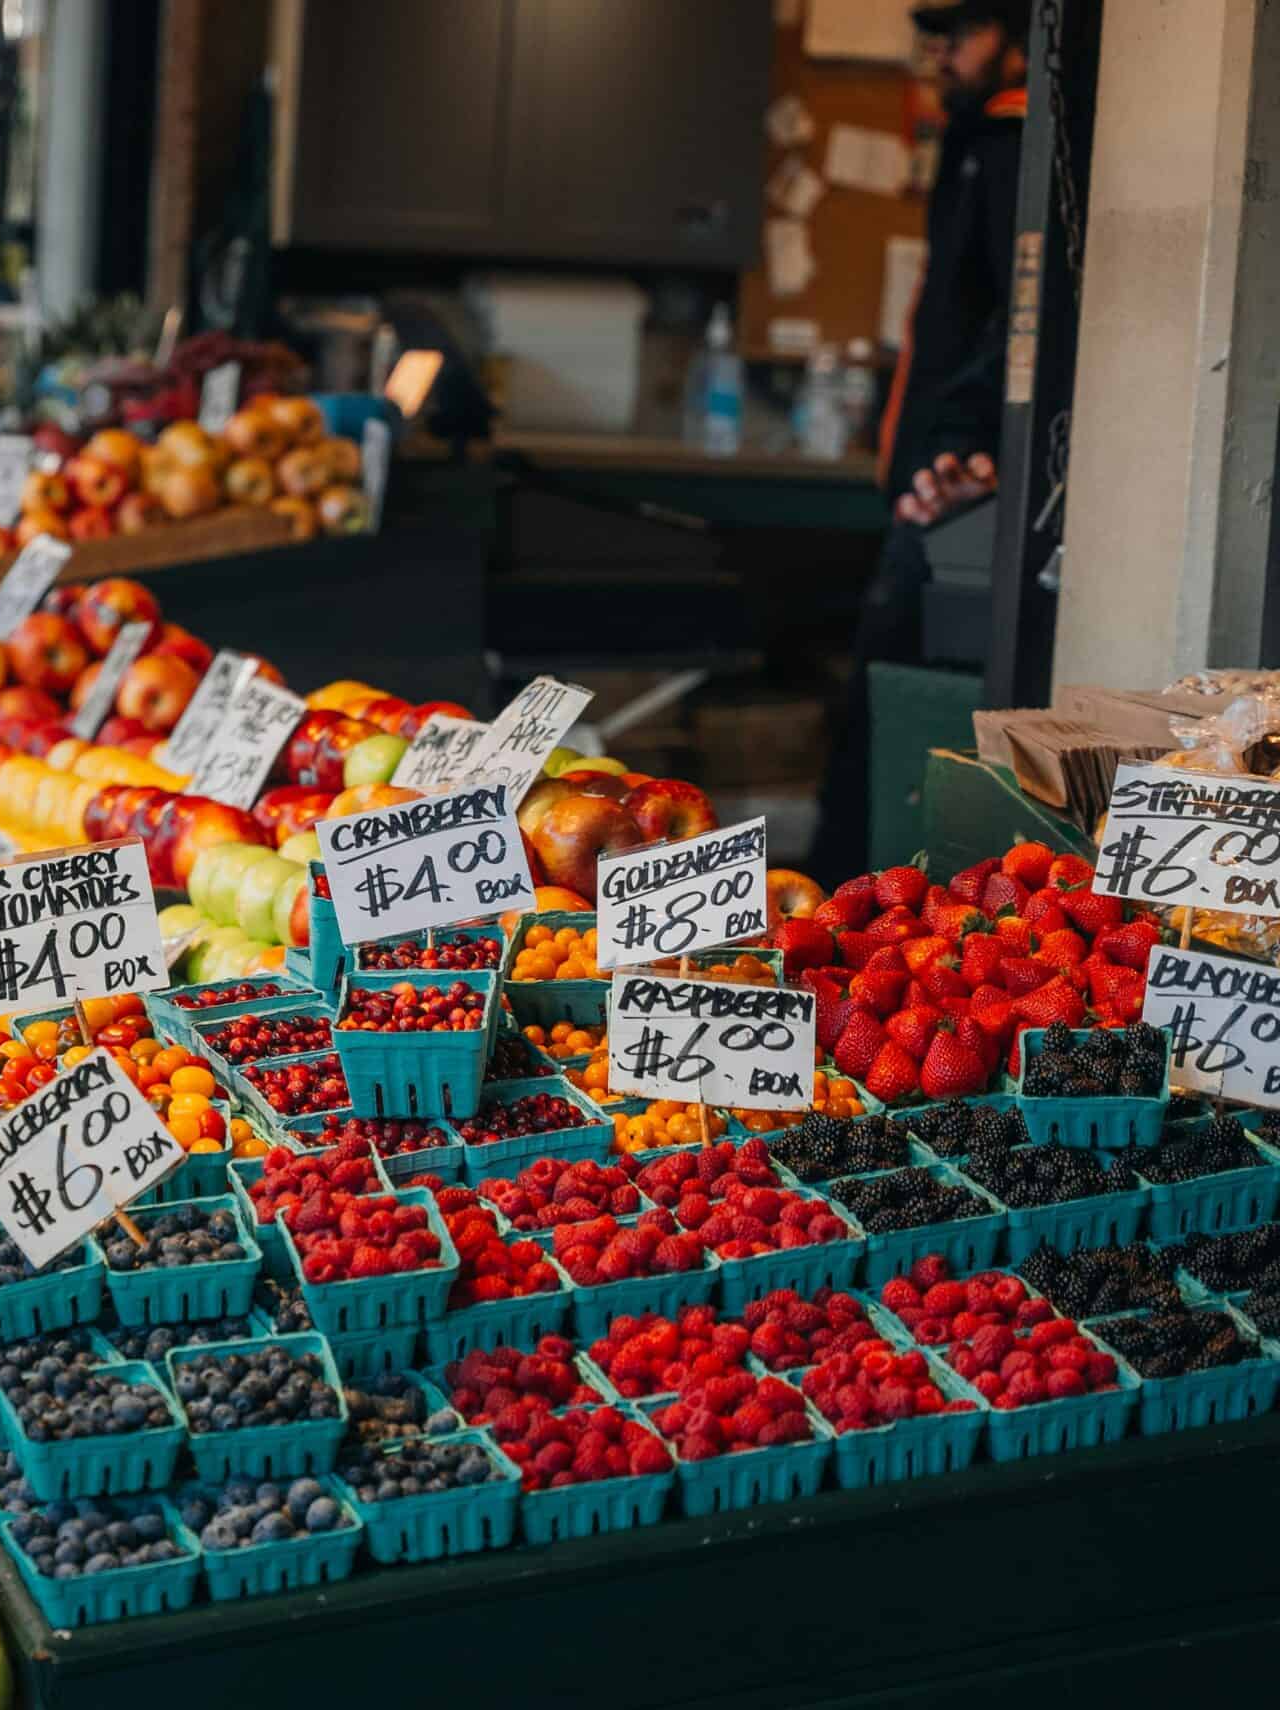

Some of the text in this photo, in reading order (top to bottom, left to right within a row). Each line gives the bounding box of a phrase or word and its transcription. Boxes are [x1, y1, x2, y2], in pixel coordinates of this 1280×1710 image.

[330, 784, 507, 852] CRANBERRY
[22, 848, 120, 890] CHERRY
[355, 830, 507, 918] $4.00
[475, 873, 531, 904] BOX
[612, 871, 754, 954] $8.00
[725, 908, 766, 938] BOX
[104, 955, 157, 991] BOX
[618, 978, 815, 1023] RASPBERRY
[617, 1022, 795, 1082] $6.00
[749, 1067, 804, 1098] BOX
[123, 1131, 173, 1181] BOX
